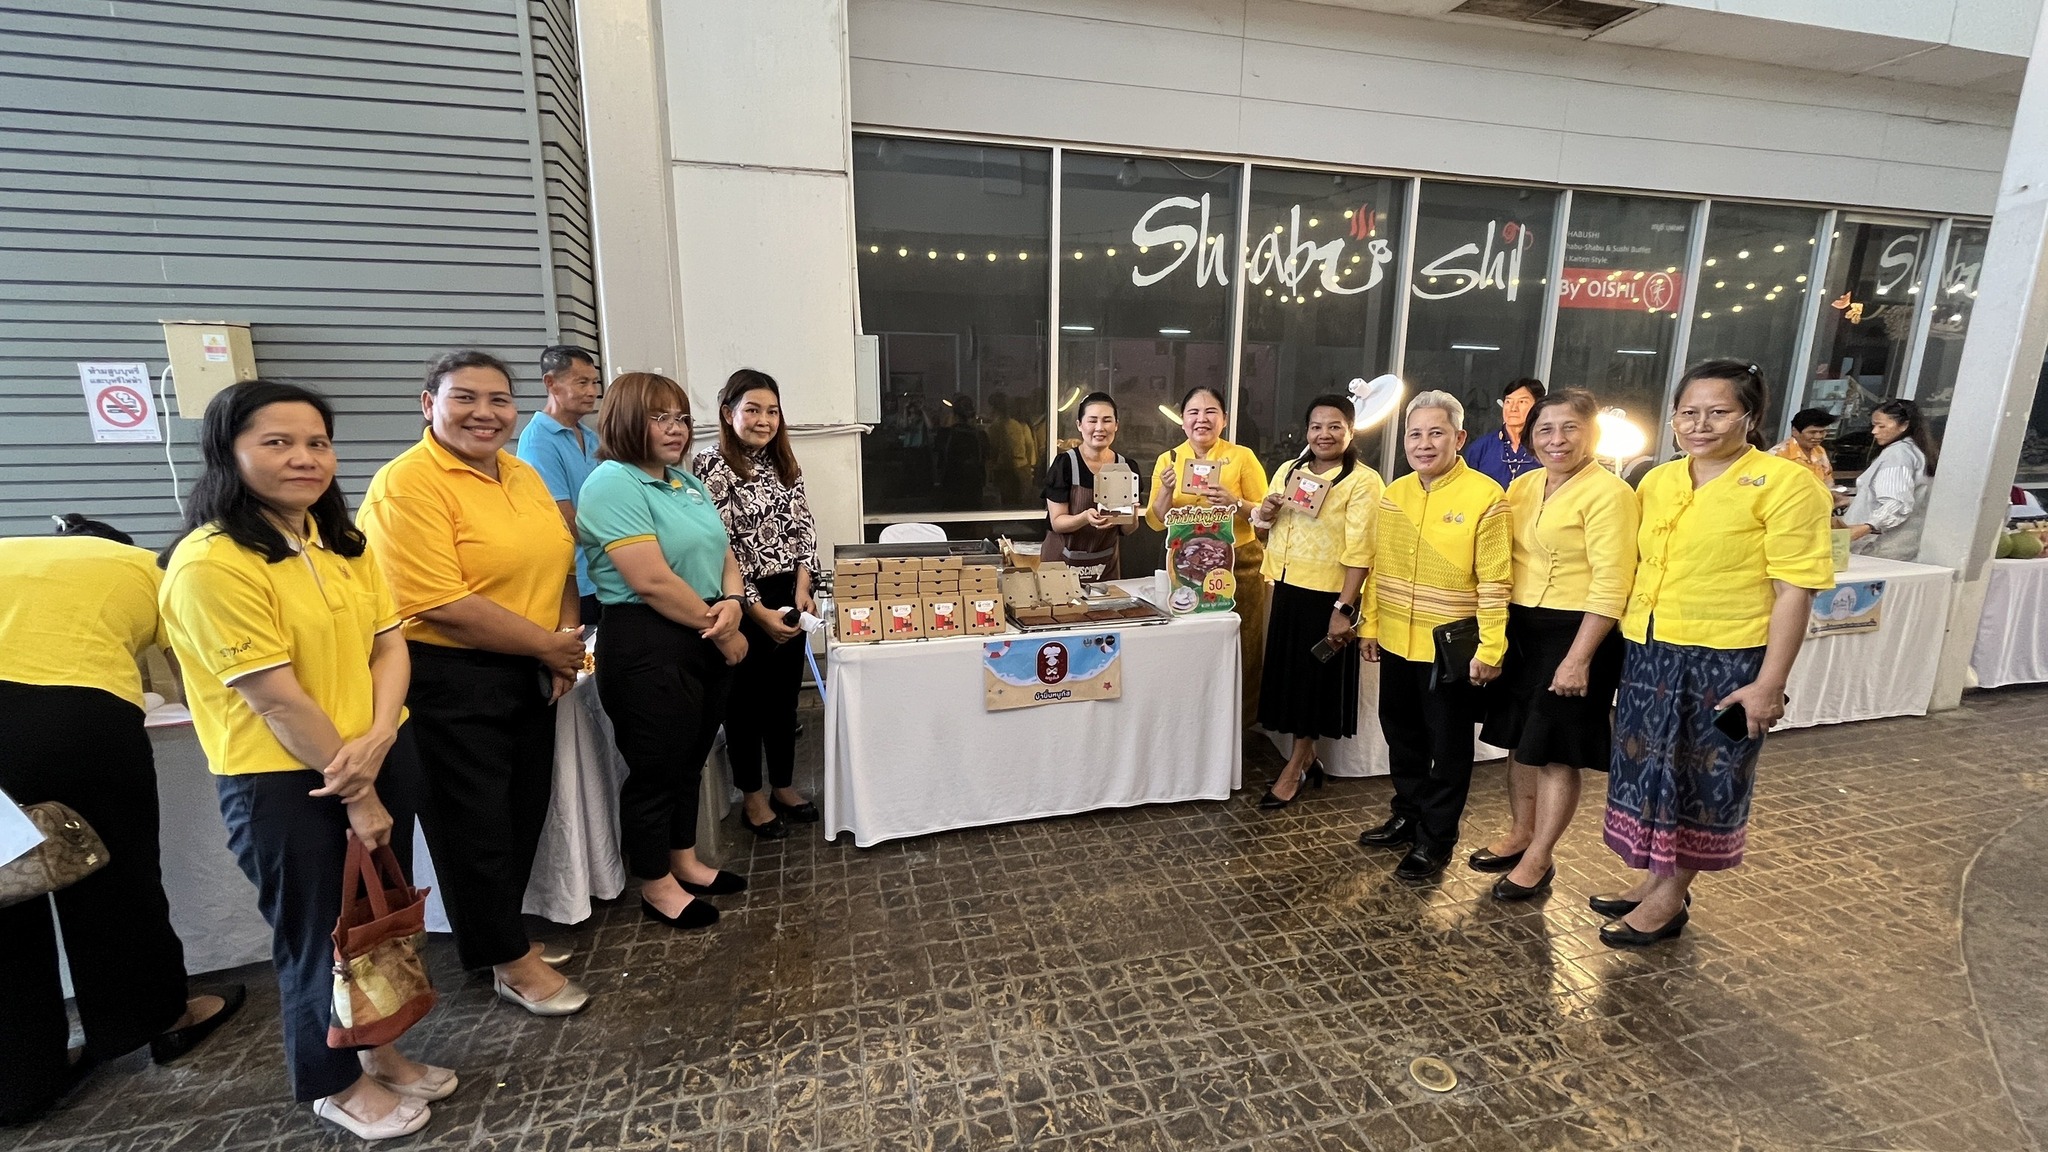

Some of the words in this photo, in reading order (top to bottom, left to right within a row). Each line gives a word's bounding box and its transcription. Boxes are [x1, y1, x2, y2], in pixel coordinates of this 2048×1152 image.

[1567, 230, 1600, 239] HABUSHI
[1560, 279, 1581, 300] By
[1587, 280, 1636, 298] OISHI
